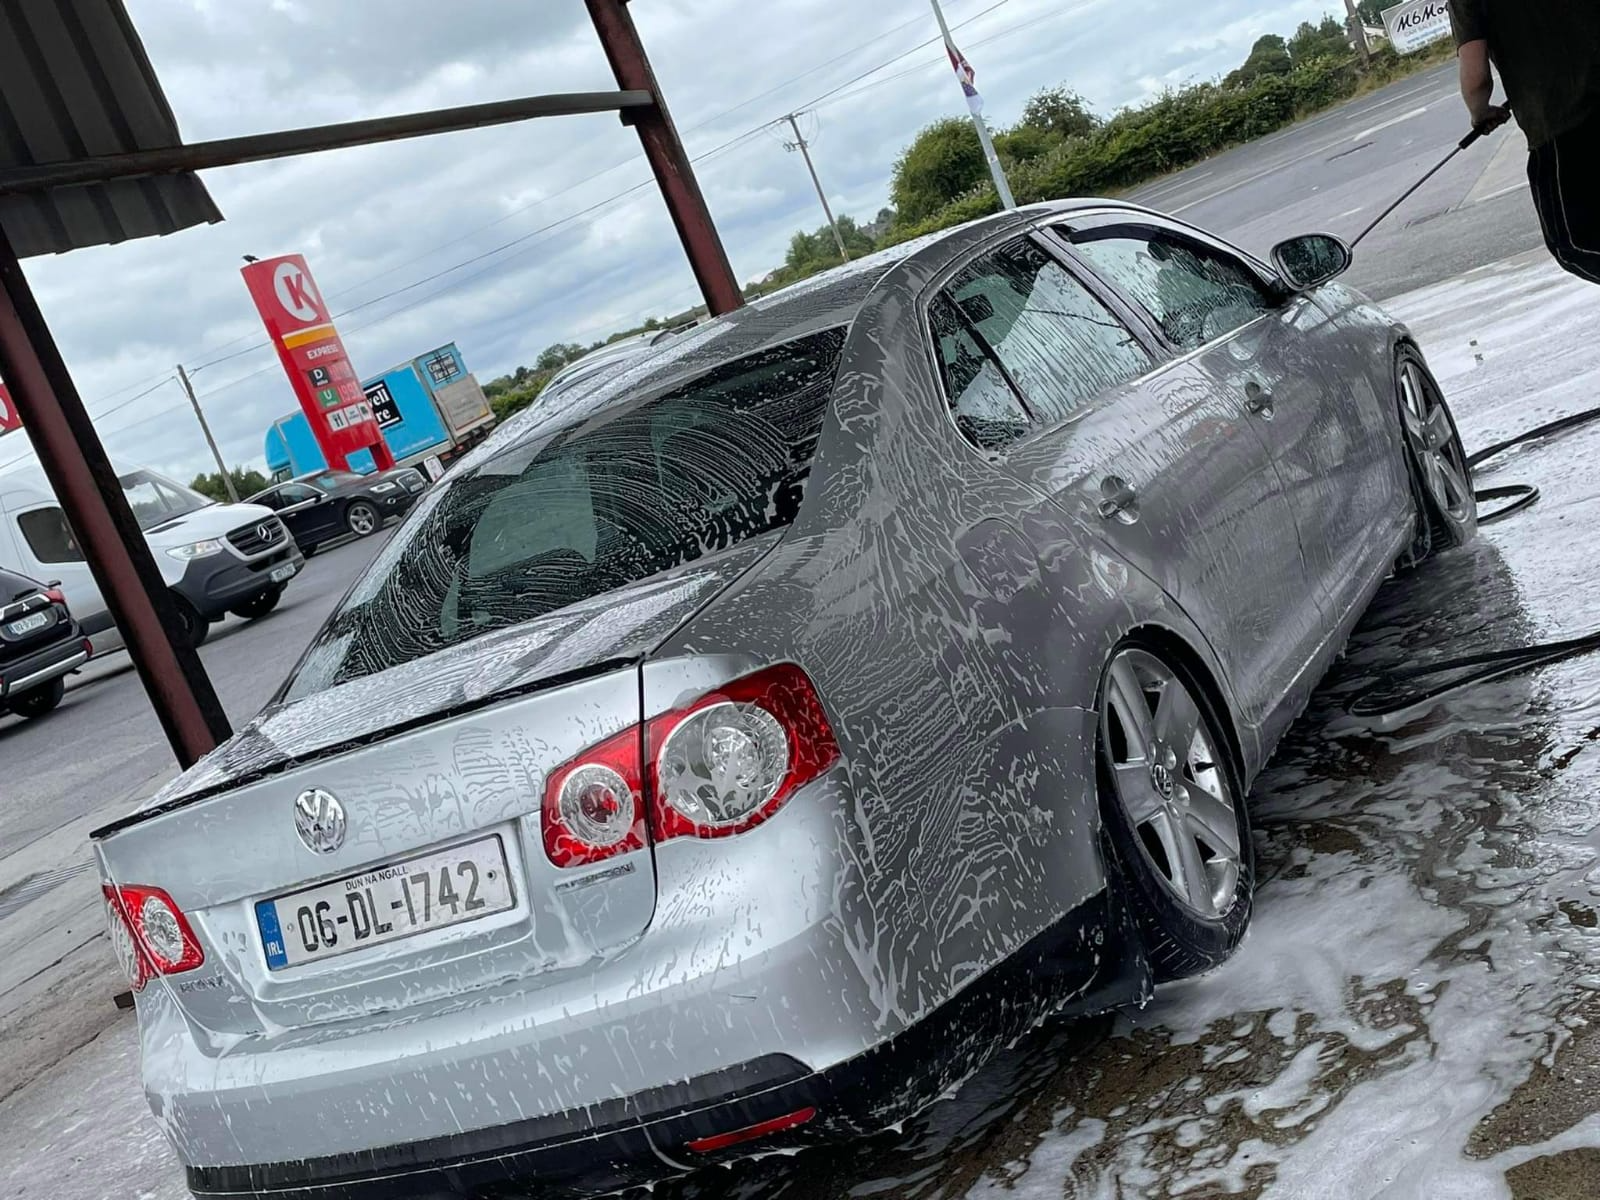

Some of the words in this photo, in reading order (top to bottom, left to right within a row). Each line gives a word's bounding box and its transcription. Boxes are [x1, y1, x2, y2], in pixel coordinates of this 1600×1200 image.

[283, 272, 318, 309] K
[306, 344, 339, 360] EXPRESS
[313, 368, 324, 380] D
[323, 389, 332, 400] U
[365, 874, 378, 885] NA
[379, 866, 409, 881] NGALL
[296, 860, 486, 953] 06-DL-1742
[267, 941, 284, 958] IRL
